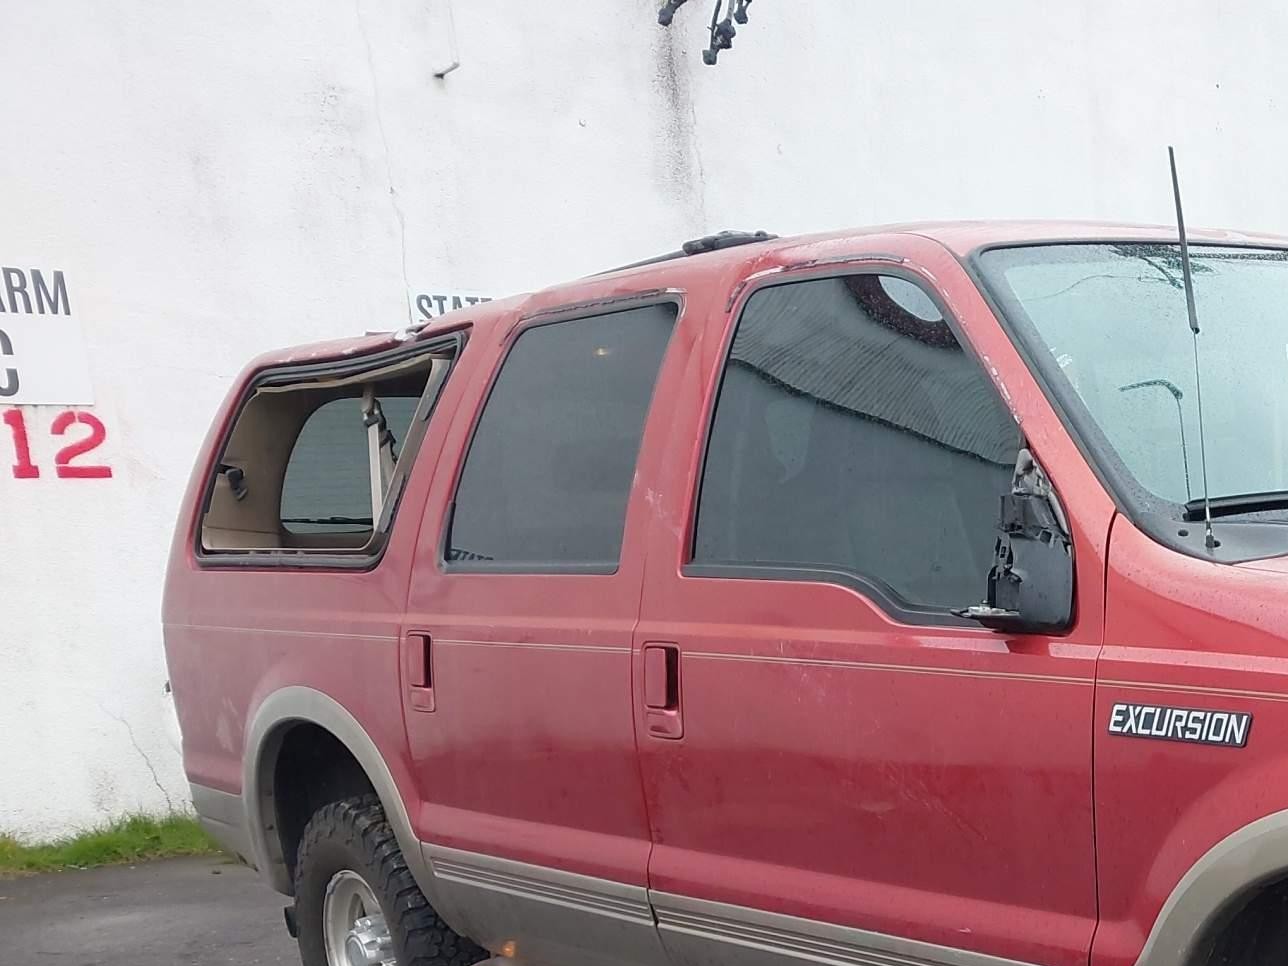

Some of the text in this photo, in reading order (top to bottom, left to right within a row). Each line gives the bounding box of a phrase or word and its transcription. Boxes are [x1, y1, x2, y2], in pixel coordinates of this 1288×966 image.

[0, 266, 72, 316] RM
[2, 408, 113, 479] 12
[1108, 704, 1249, 745] EXCURSION
